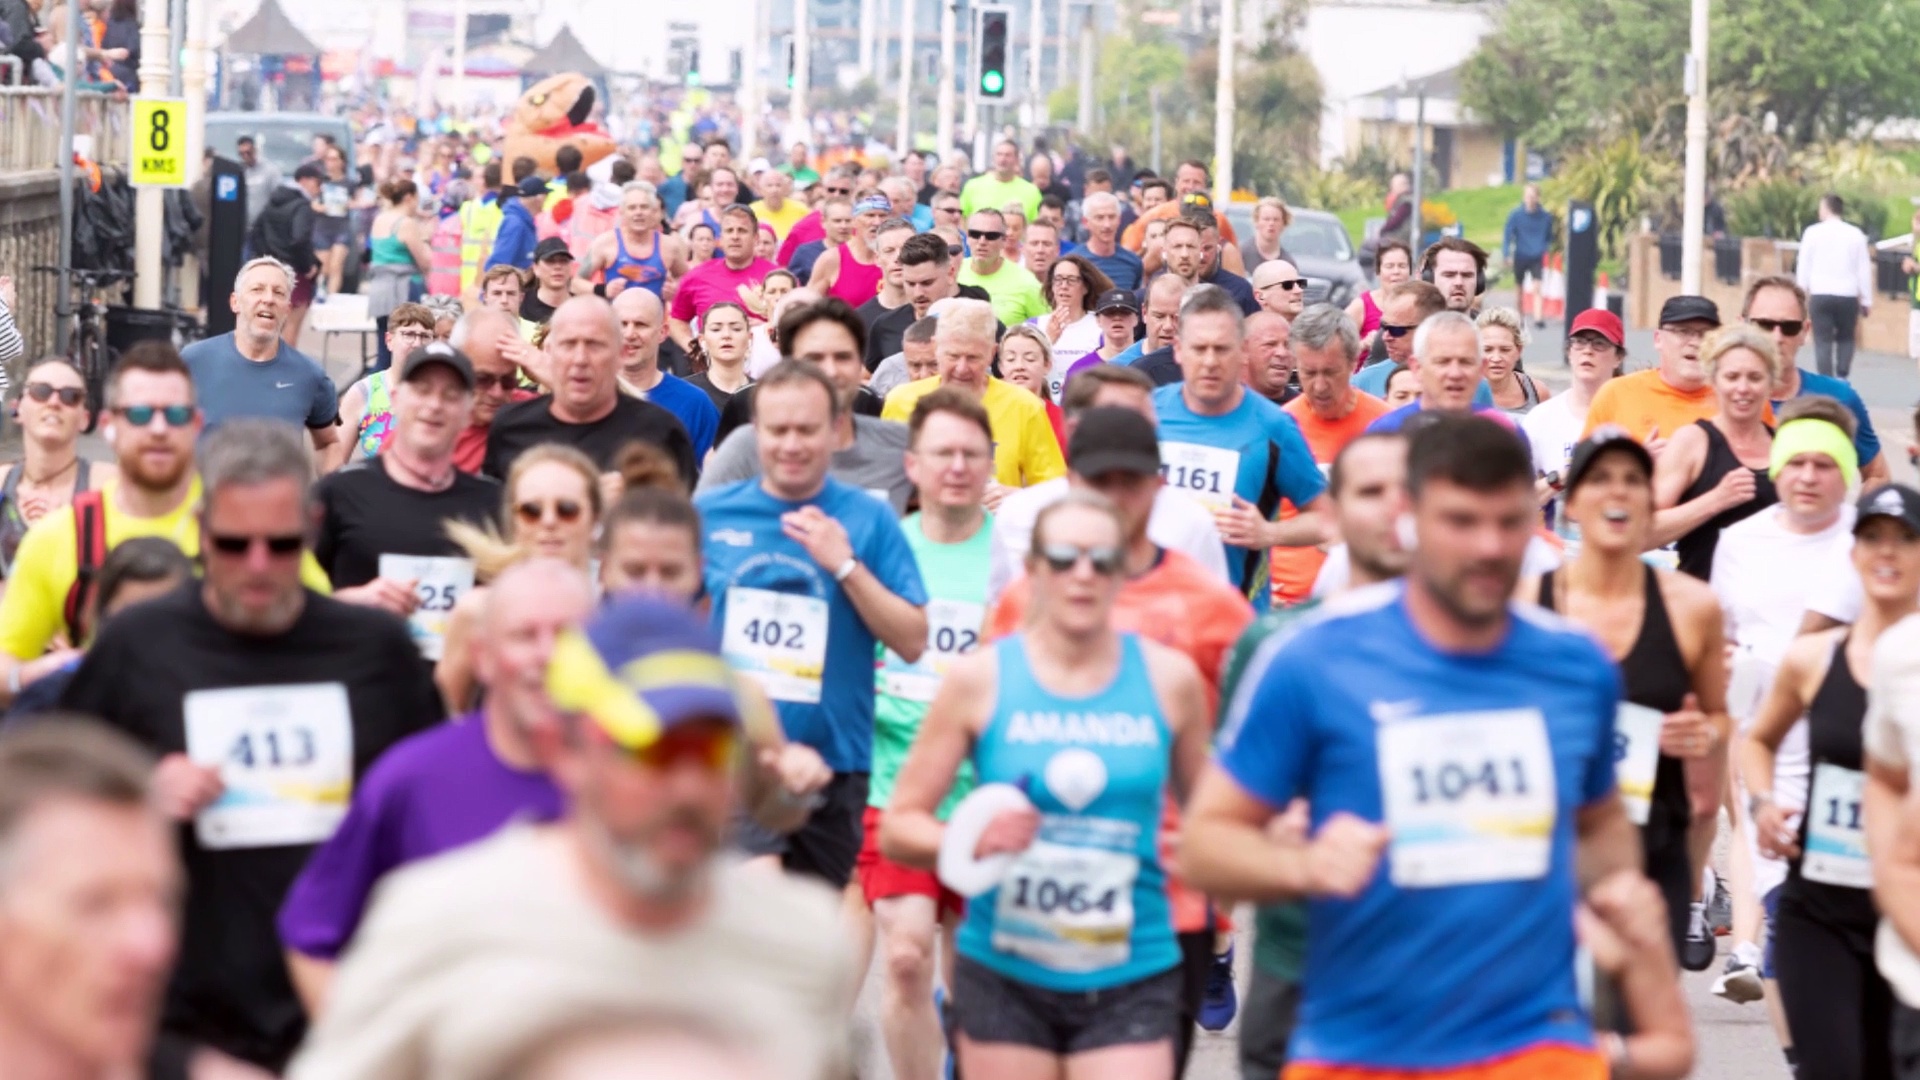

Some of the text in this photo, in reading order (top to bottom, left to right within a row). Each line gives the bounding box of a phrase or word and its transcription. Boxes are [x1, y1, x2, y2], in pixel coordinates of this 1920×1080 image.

[150, 109, 169, 152] 8
[142, 157, 176, 174] KMS
[217, 175, 237, 199] P
[1158, 463, 1221, 494] 1161
[418, 585, 456, 611] 25
[743, 618, 805, 650] 402
[926, 627, 977, 653] 02
[1005, 711, 1160, 746] AMANDA
[229, 724, 315, 767] 413
[1410, 757, 1528, 804] 1041
[1824, 798, 1862, 830] 11
[1013, 876, 1117, 916] 1064
